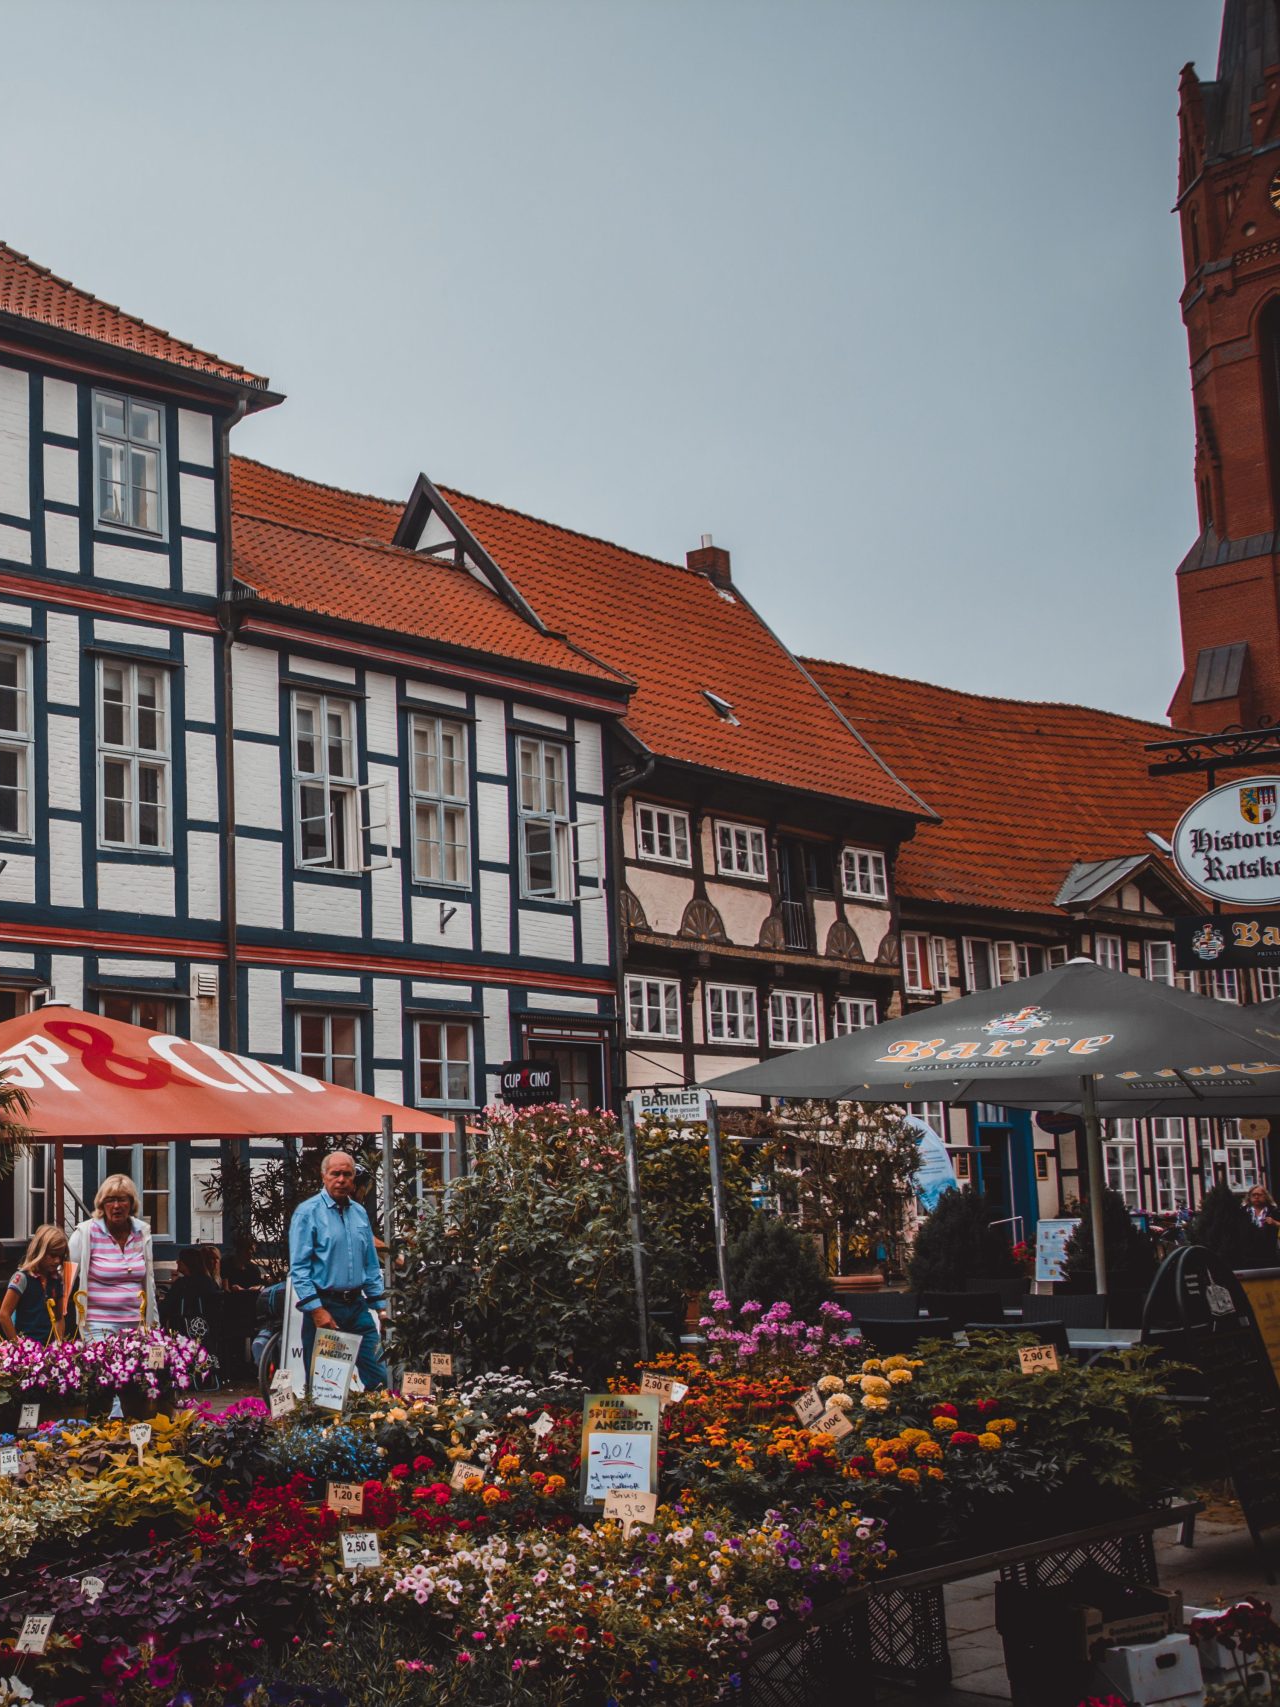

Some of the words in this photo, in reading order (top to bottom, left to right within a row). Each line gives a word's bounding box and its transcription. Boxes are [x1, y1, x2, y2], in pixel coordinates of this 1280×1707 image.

[875, 1034, 1114, 1063] Barre
[43, 1021, 205, 1090] &
[504, 1073, 521, 1089] CUP
[529, 1071, 550, 1088] CINO
[641, 1093, 700, 1107] BARMER
[1023, 1352, 1043, 1362] 2,90
[1045, 1350, 1052, 1359] €
[644, 1379, 662, 1390] 2,90
[664, 1383, 670, 1392] €
[595, 1420, 653, 1432] ANGEBOT:
[333, 1489, 352, 1501] 1,20
[354, 1491, 361, 1501] €
[346, 1541, 367, 1553] 2,50
[369, 1540, 376, 1551] €
[41, 1623, 48, 1635] €
